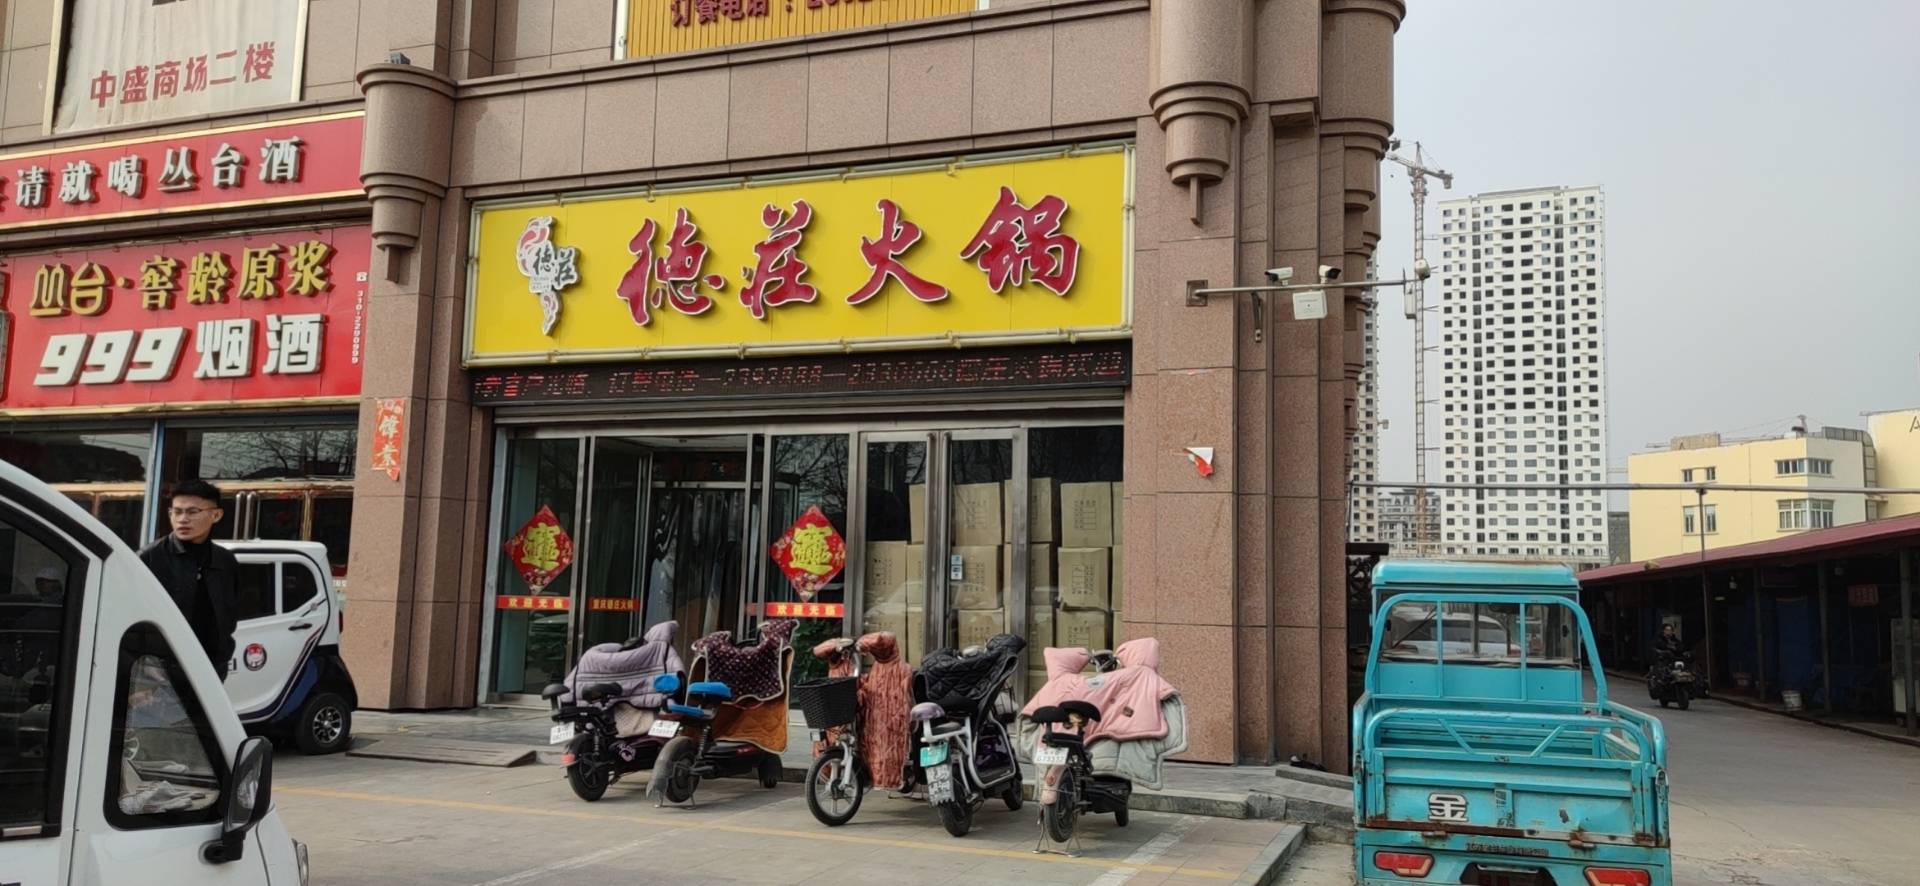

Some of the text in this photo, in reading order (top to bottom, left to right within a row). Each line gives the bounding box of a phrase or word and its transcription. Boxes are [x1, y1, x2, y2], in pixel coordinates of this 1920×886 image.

[90, 41, 276, 108] 中盛商场二楼
[0, 136, 303, 208] 请就喝丛台酒
